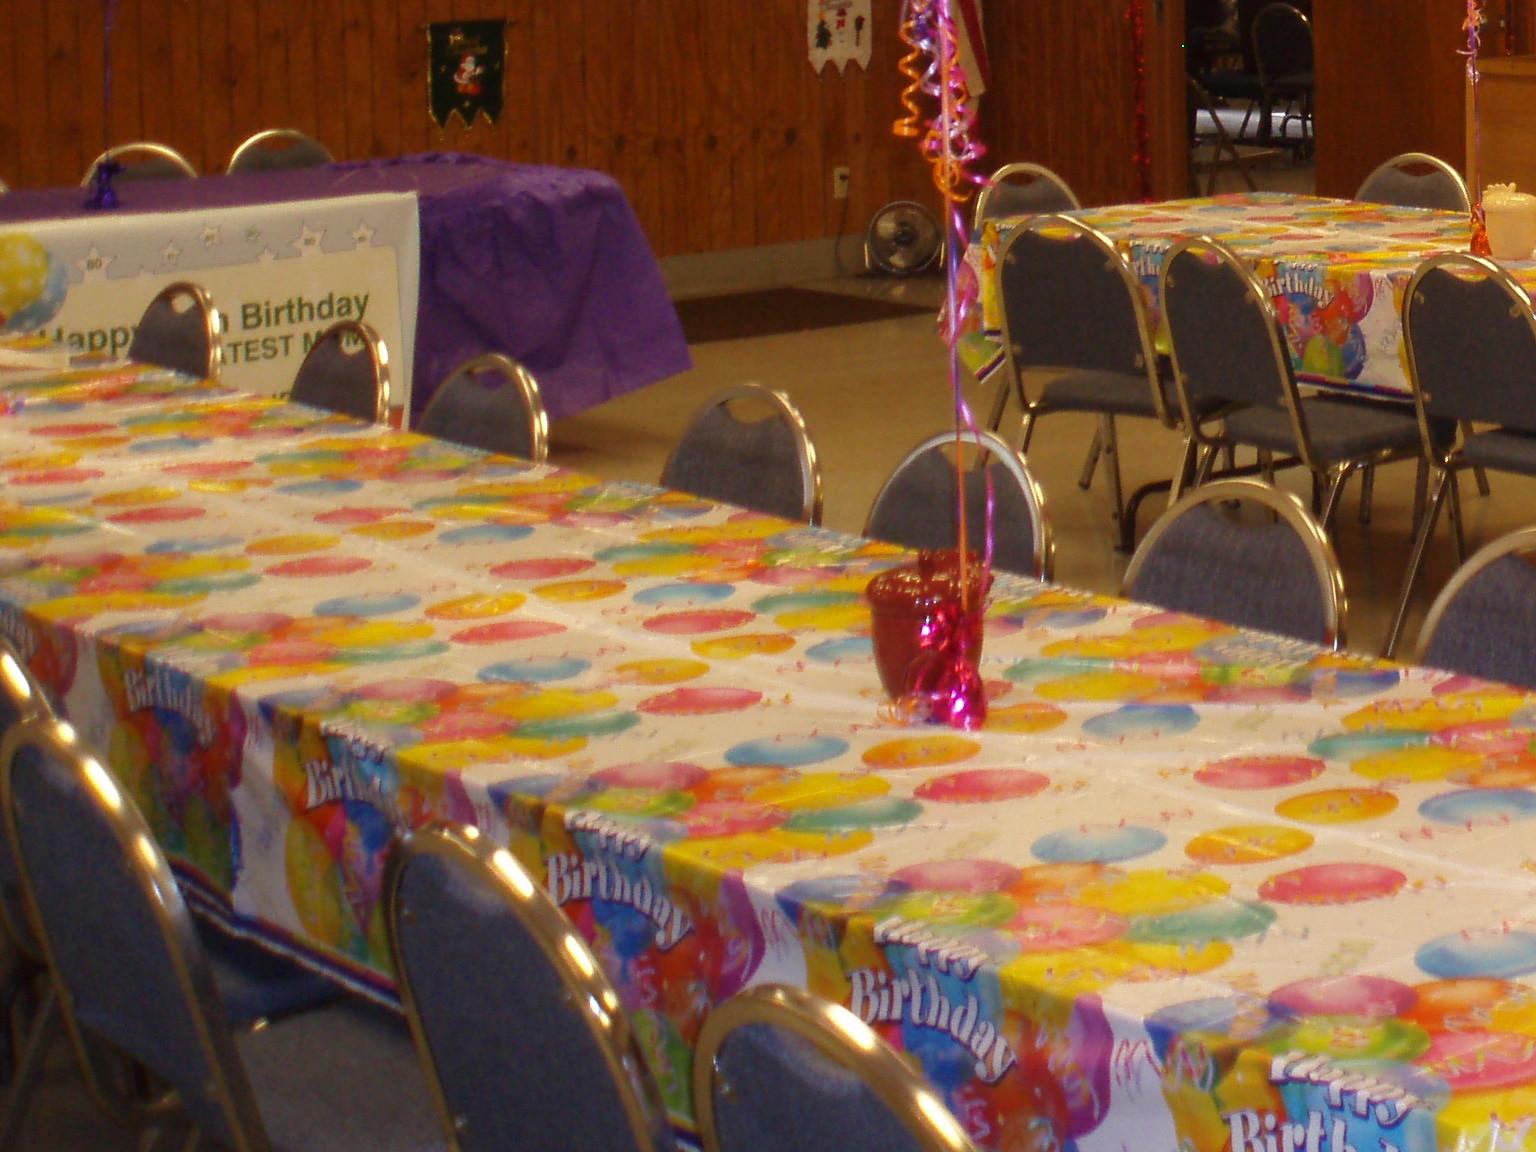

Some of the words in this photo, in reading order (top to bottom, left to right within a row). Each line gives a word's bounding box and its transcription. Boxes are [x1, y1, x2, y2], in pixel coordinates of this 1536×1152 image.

[241, 292, 369, 331] Birthday
[545, 850, 696, 951] Birthday
[847, 966, 1018, 1084] Birthday
